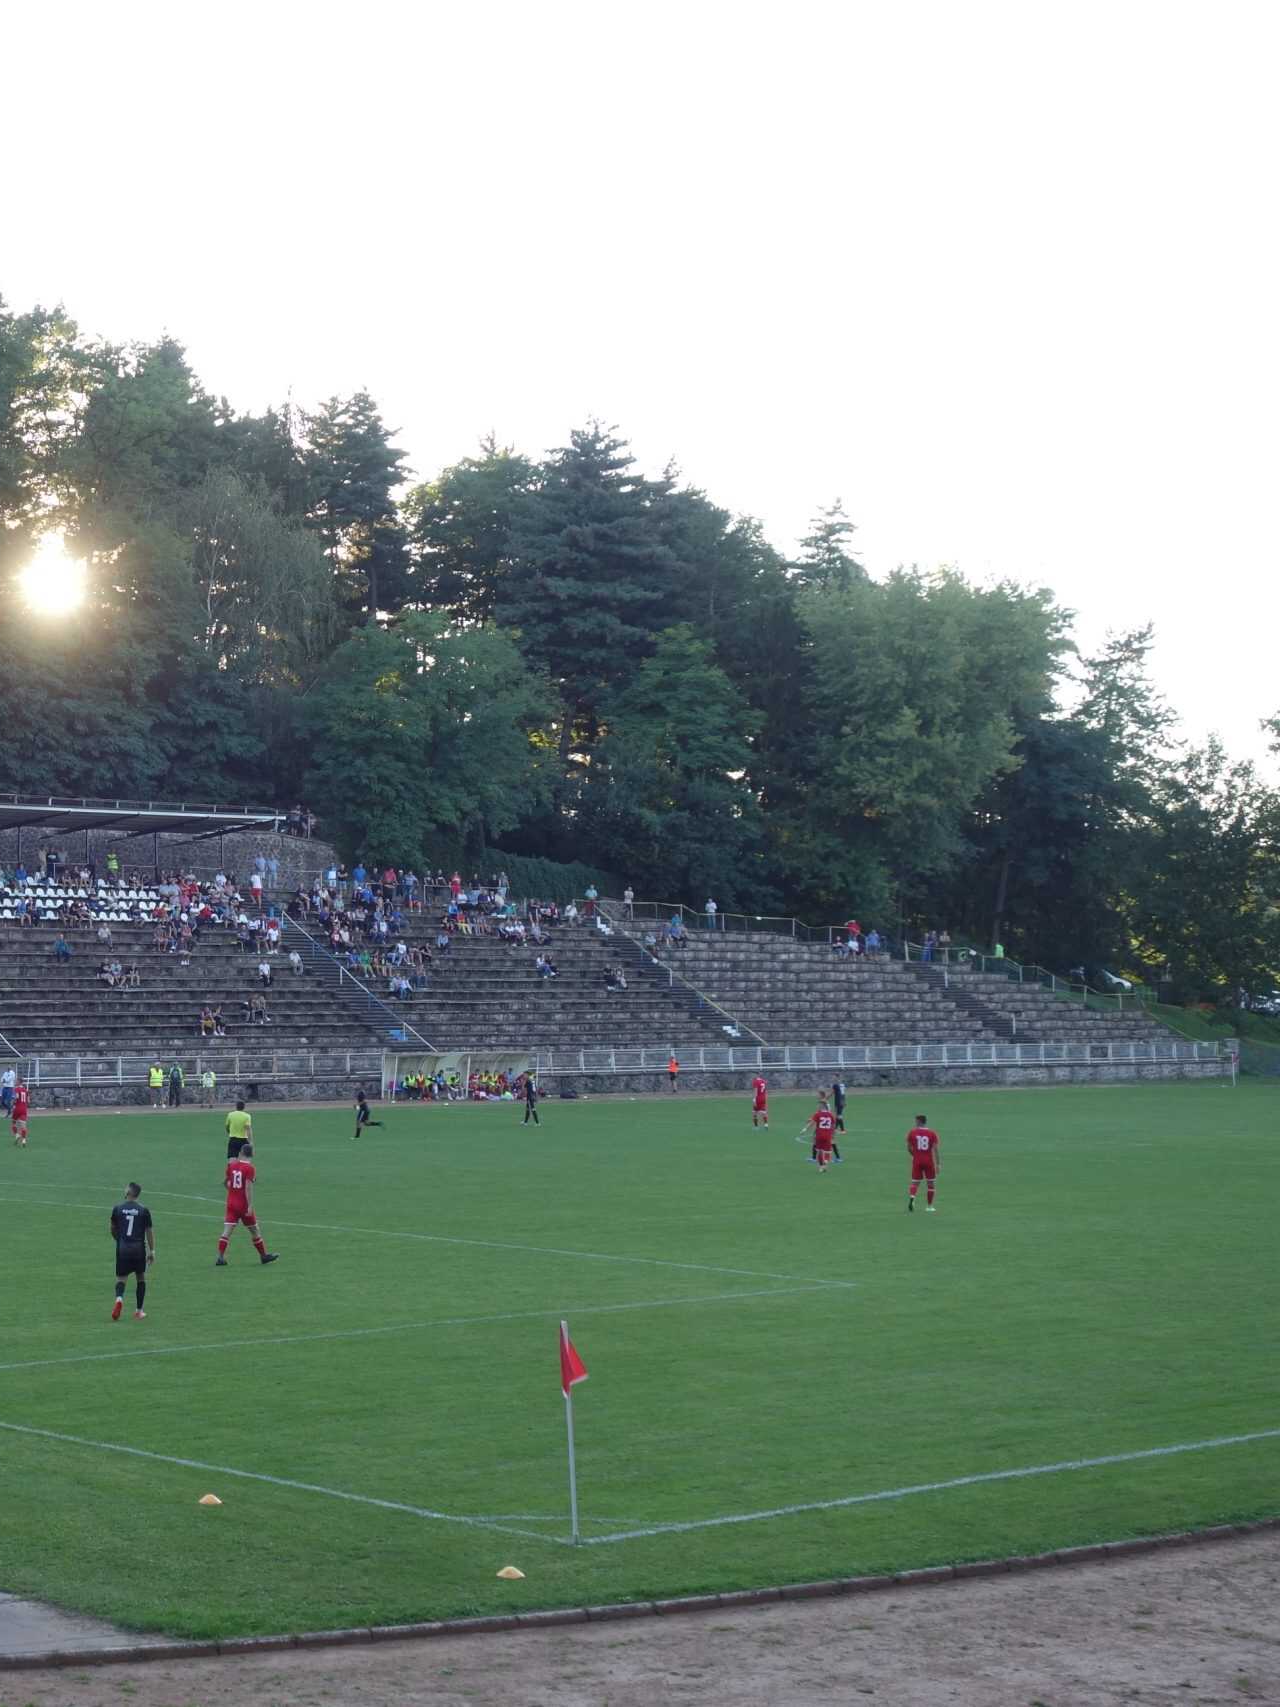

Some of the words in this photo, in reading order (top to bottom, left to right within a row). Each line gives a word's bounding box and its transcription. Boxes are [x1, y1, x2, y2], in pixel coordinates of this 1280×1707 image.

[819, 1117, 832, 1129] 23
[916, 1136, 929, 1150] 18
[232, 1170, 242, 1189] 13
[126, 1216, 134, 1236] 7
